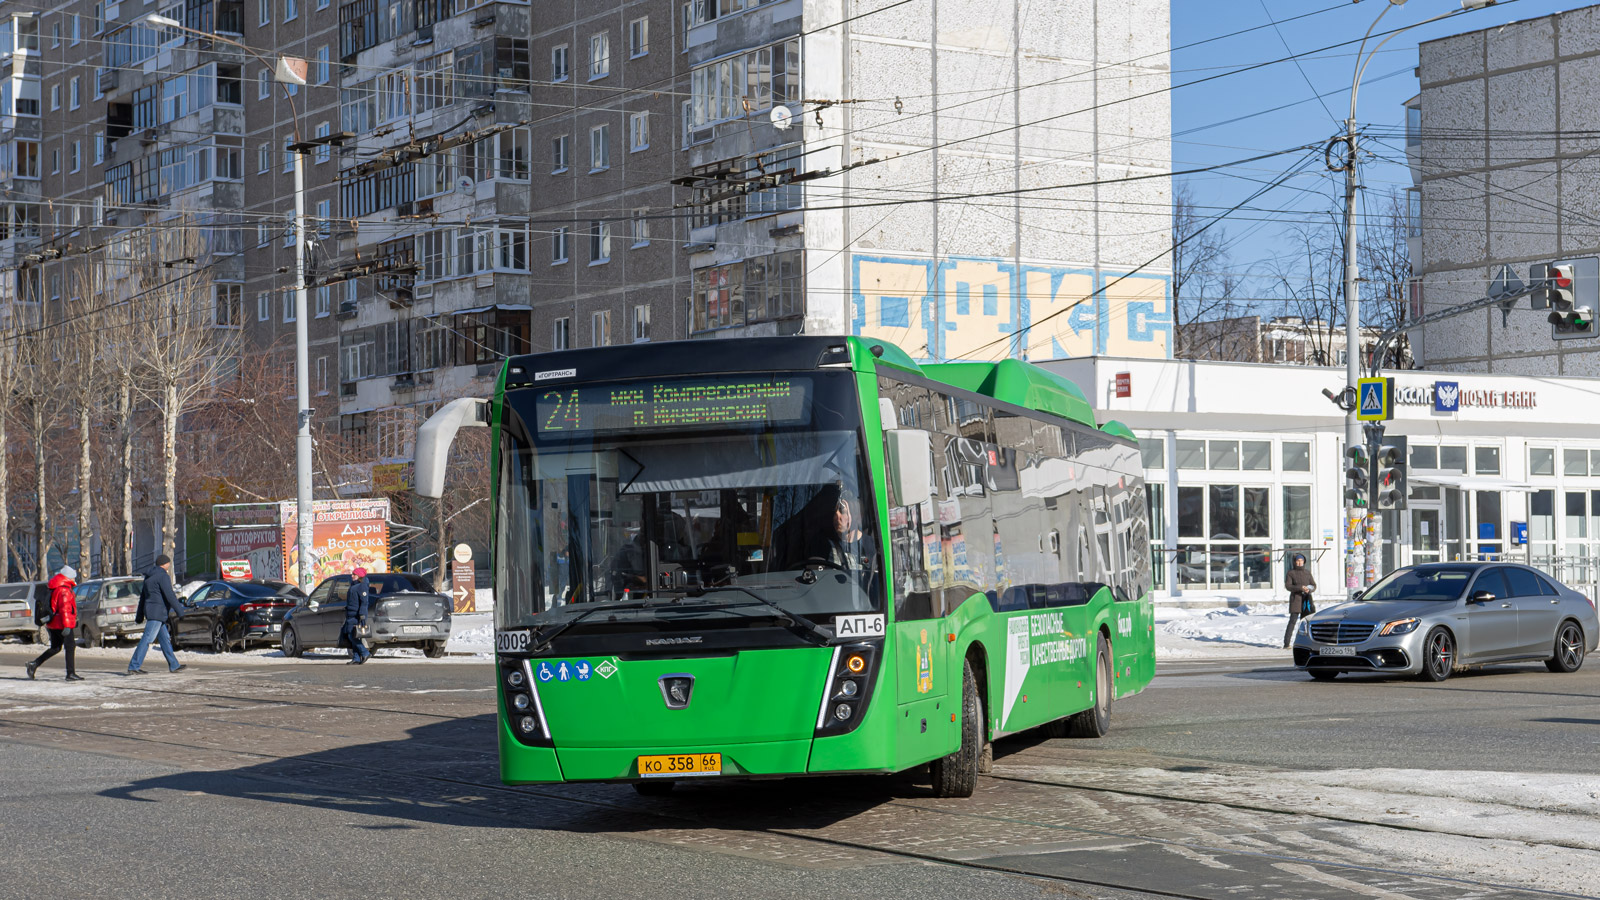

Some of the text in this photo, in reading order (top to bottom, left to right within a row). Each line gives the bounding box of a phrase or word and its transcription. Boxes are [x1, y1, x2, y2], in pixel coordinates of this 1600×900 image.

[653, 381, 790, 403] Компрессорный
[1394, 386, 1434, 404] ОССИИ
[1459, 389, 1537, 407] ПОЧТА БАНК
[543, 389, 581, 428] 24
[633, 404, 767, 425] п. Мичуринский
[220, 530, 276, 545] МИР СУХОФРУКТОВ
[340, 524, 382, 537] Дары
[327, 537, 385, 549] Востока
[840, 617, 882, 634] АП-6
[1031, 613, 1064, 636] БЕЗОПАСНЫЕ
[497, 633, 528, 650] 2009
[1031, 640, 1069, 666] КАЧЕСТВЕННЫЕ
[645, 755, 716, 772] КО 358 66
